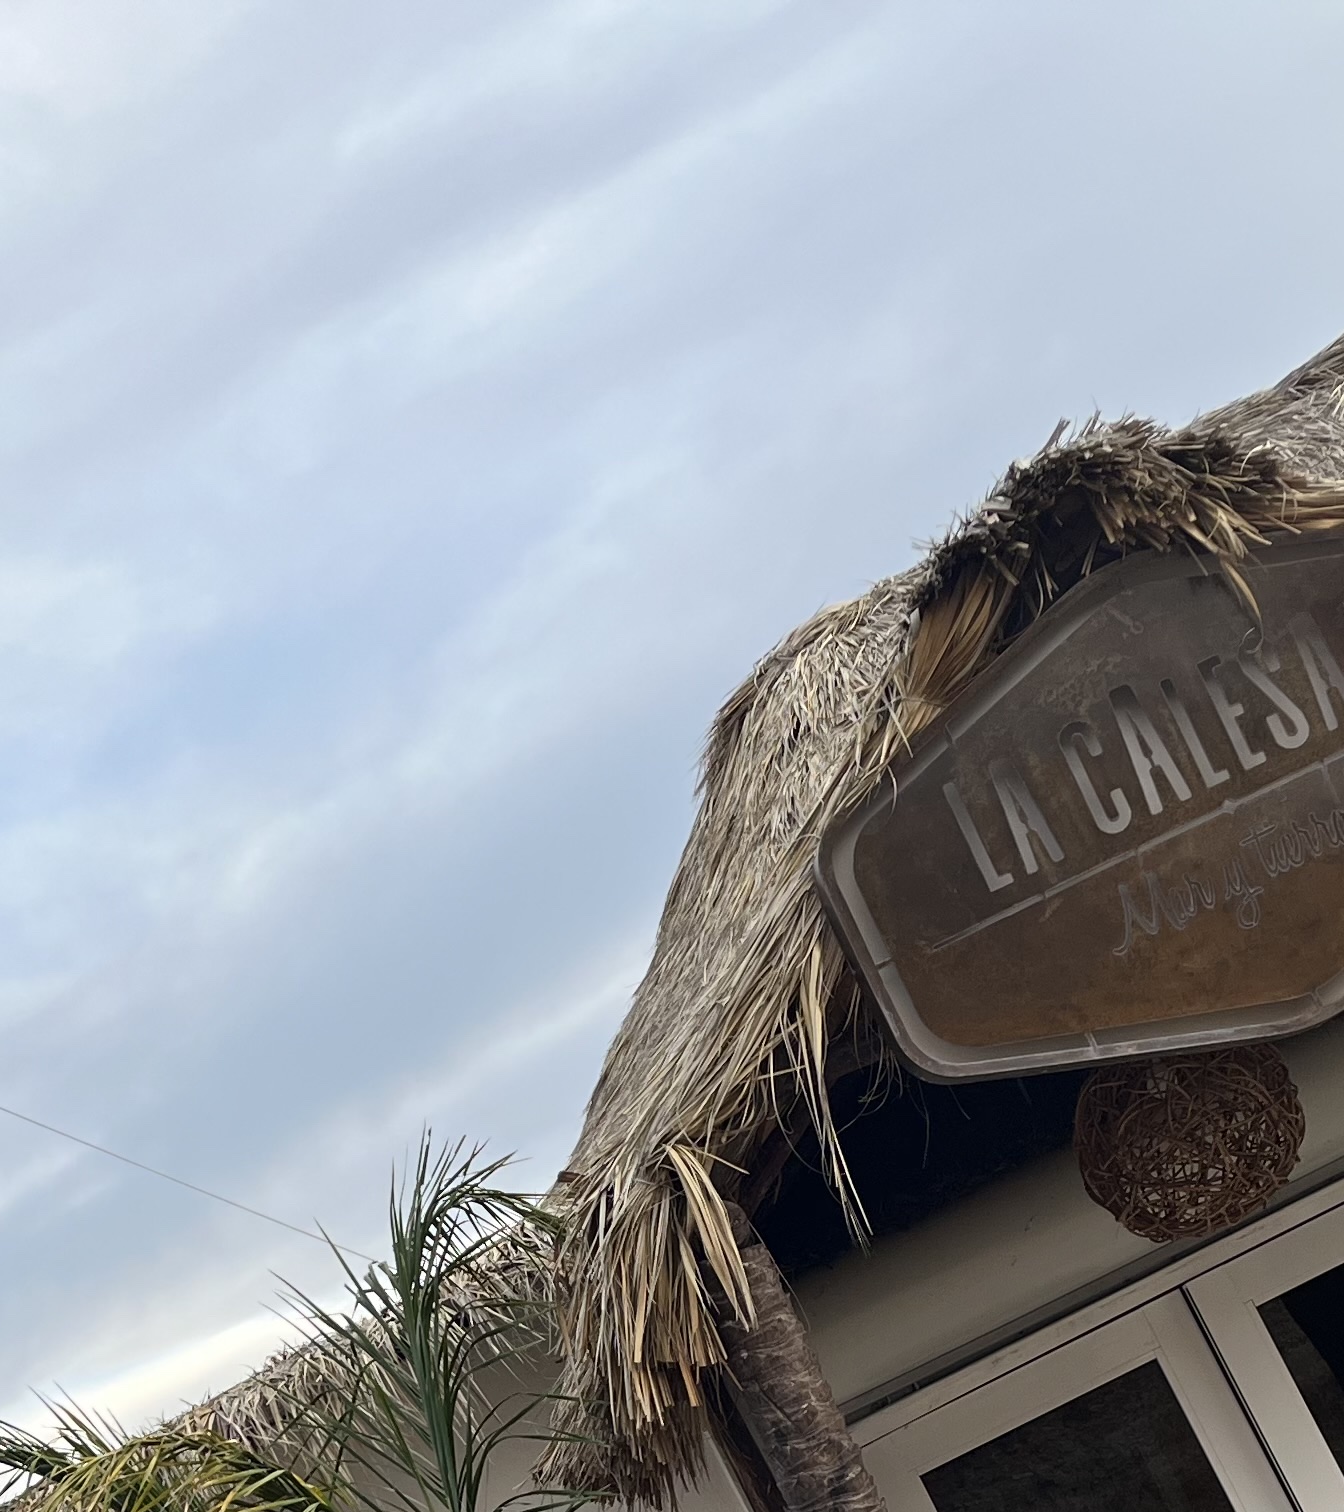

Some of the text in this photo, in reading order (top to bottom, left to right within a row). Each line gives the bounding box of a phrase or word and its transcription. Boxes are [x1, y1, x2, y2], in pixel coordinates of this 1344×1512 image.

[942, 761, 1065, 893] LA
[1112, 870, 1216, 956] Mar
[1222, 856, 1264, 930] y
